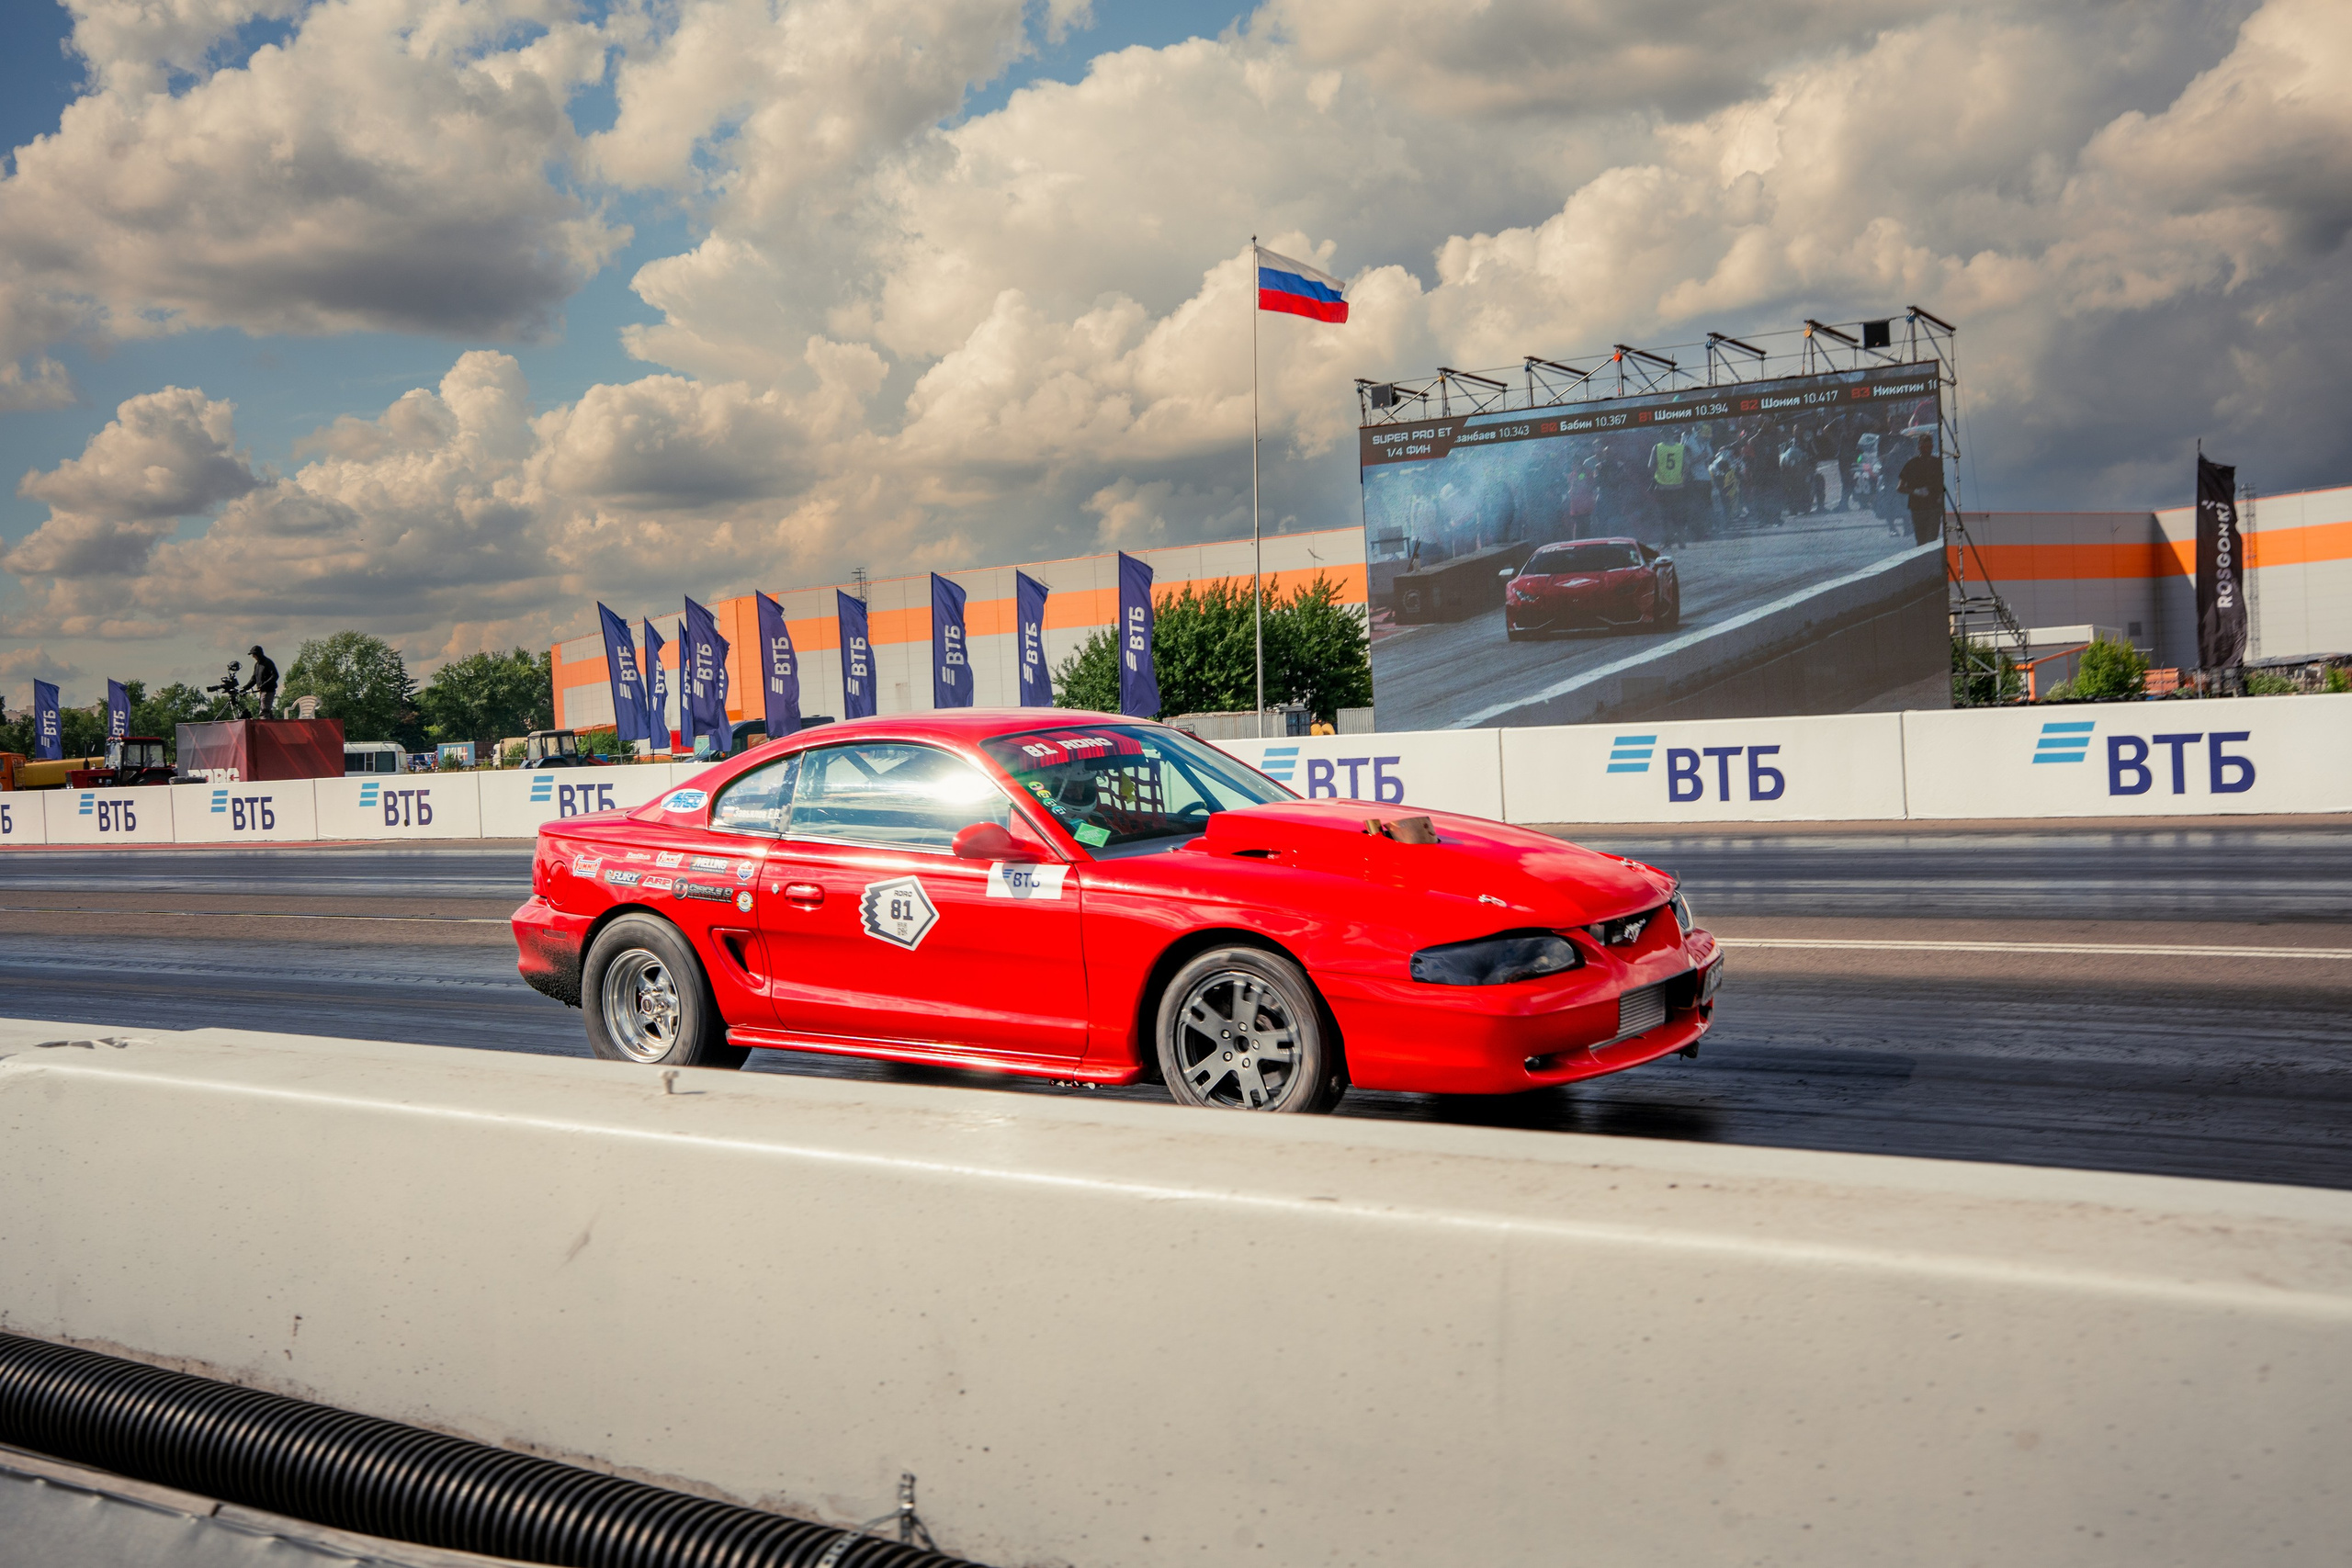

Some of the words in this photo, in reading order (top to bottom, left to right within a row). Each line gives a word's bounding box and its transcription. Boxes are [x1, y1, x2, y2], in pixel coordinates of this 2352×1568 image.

[1454, 430, 1496, 444] занбаев
[1499, 424, 1531, 438] 10.343
[1560, 419, 1592, 432] Бабин
[1595, 413, 1627, 427] 10.367
[1654, 408, 1692, 422] Шония
[1694, 402, 1729, 417] 10.394
[1740, 399, 1759, 412] 82
[1760, 395, 1801, 410] Шония
[1803, 389, 1838, 404] 10.417
[1851, 386, 1871, 399] 83
[1873, 380, 1925, 397] Никитин
[1373, 431, 1408, 445] SUPER
[1412, 429, 1434, 441] PRO
[1438, 426, 1453, 437] ET
[1386, 446, 1403, 457] 1/4
[1406, 444, 1431, 456] ФИН
[1666, 453, 1676, 470] 5
[2216, 502, 2234, 609] ROSGONKI
[944, 624, 966, 666] ВТБ
[1024, 621, 1039, 666] ВТБ
[1128, 605, 1147, 651] ВТБ
[696, 642, 714, 681] ВТБ
[772, 636, 792, 676] ВТБ
[849, 636, 868, 678] ВТБ
[43, 709, 57, 736] ВТБ
[112, 710, 126, 736] ВТБ
[1306, 756, 1405, 806] ВТБ
[1667, 744, 1785, 803] ВТБ
[2107, 730, 2256, 797] ВТБ
[97, 799, 137, 832] ВТБ
[232, 796, 276, 830] ВТБ
[383, 789, 433, 827] ВТБ
[559, 783, 616, 818] ВТБ
[611, 870, 641, 883] FURY
[646, 876, 670, 885] ARP
[890, 898, 914, 921] 81
